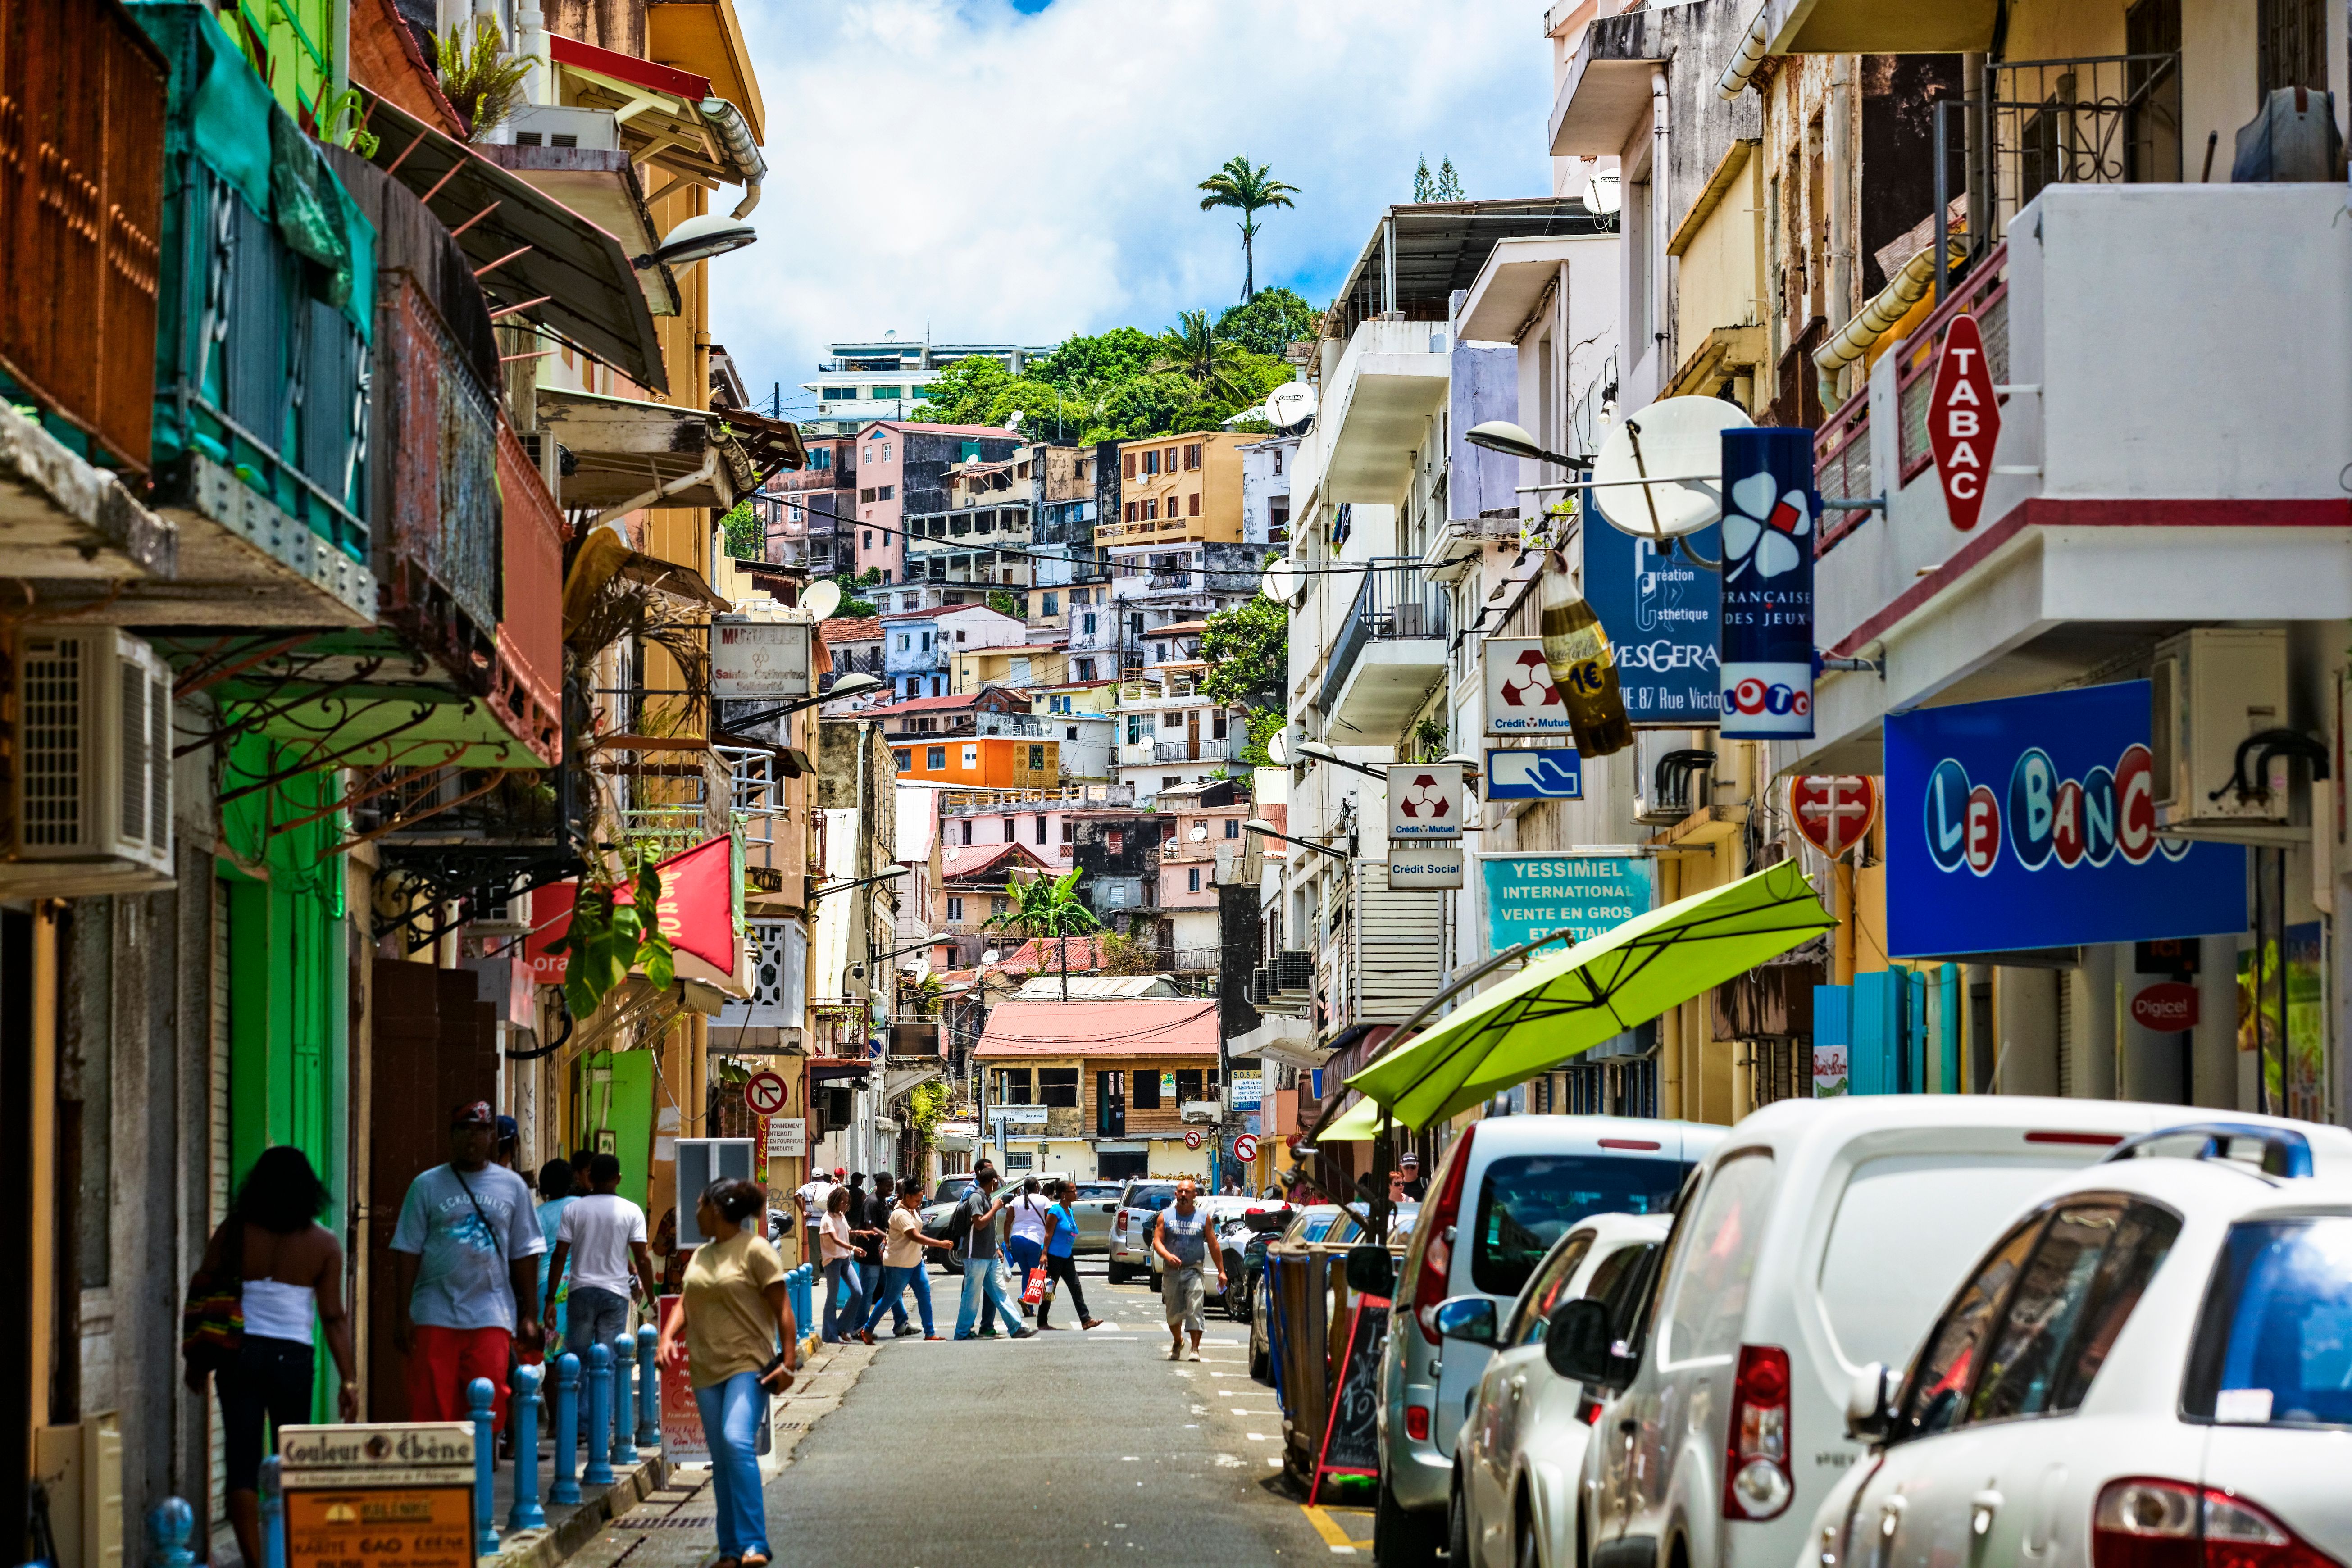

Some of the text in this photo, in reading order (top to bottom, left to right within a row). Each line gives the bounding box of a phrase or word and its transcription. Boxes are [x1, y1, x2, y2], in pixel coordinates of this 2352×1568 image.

[1947, 348, 1980, 499] TABAC
[1725, 613, 1753, 625] DES
[1763, 613, 1806, 627] JEUX
[722, 628, 800, 645] MUTUELLE
[1569, 662, 1603, 693] 1€
[1659, 687, 1683, 709] Rue
[1689, 687, 1720, 709] Victo
[1723, 678, 1809, 715] LOTO
[1495, 718, 1570, 728] Crédit Mutue
[2023, 753, 2186, 856] BANC
[1933, 768, 1991, 867] LE
[1392, 864, 1459, 873] Crédit Social
[1512, 862, 1623, 878] YESSIMIEL
[1503, 885, 1634, 899] INTERNATIONAL
[1501, 906, 1633, 920] VENTE EN GROS
[1529, 927, 1550, 940] ET
[534, 956, 569, 972] ora
[2136, 999, 2188, 1018] Digicel
[439, 1194, 472, 1213] ECKO
[1173, 1227, 1196, 1236] ARIZONA
[285, 1434, 359, 1462] Couleur
